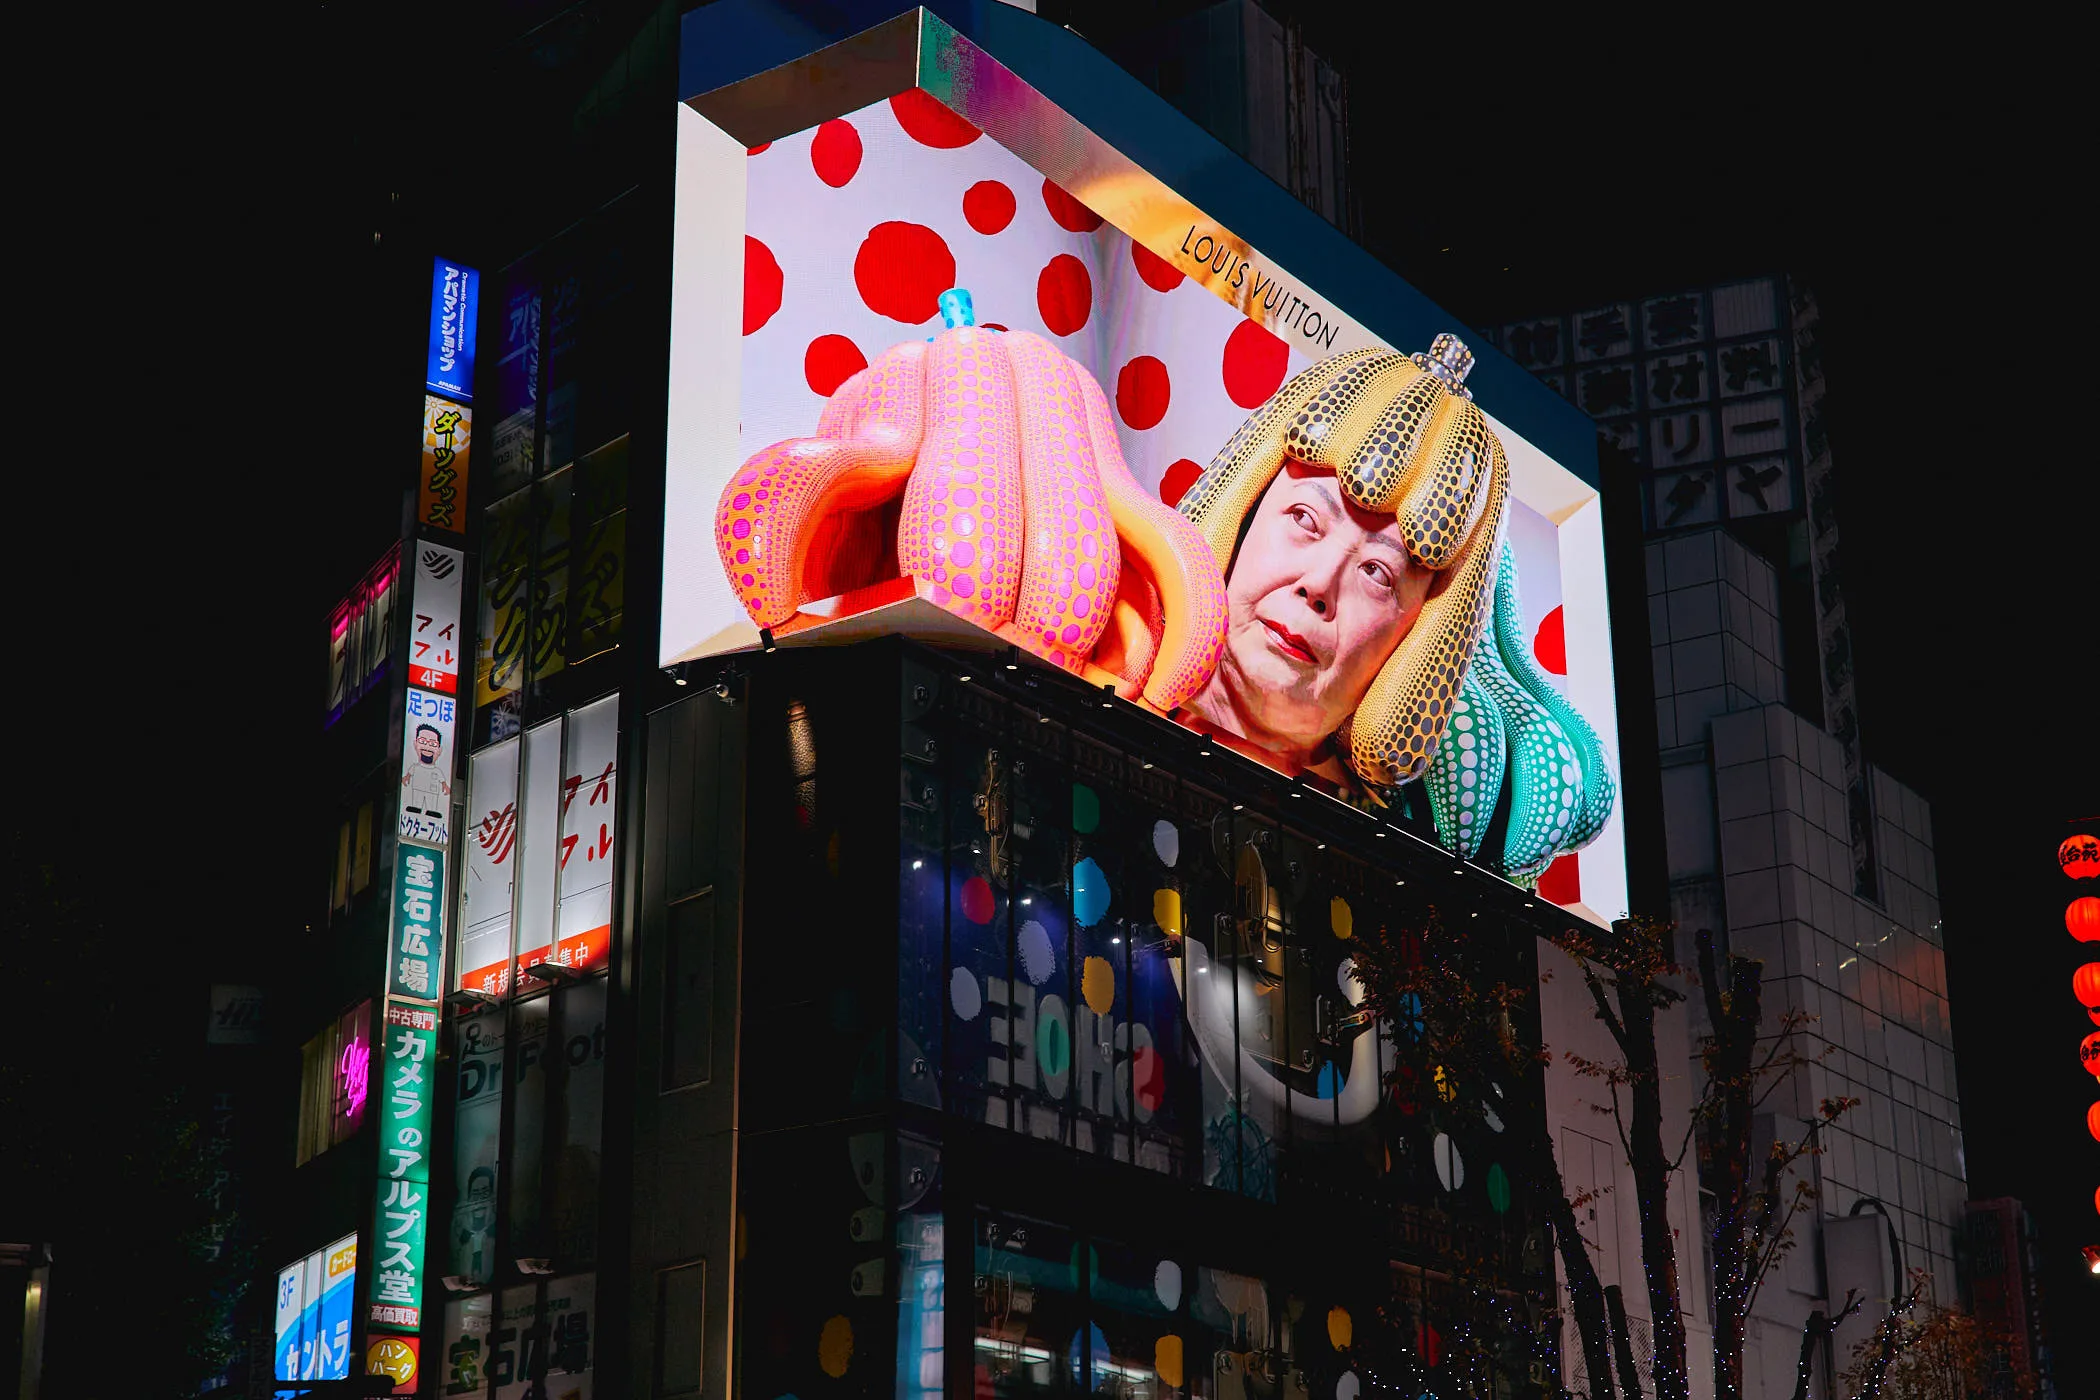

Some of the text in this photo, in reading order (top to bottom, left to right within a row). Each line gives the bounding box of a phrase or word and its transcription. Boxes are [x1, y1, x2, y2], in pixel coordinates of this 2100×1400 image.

[1181, 225, 1340, 350] LOUIS VUITTON
[440, 266, 459, 372] アパマンショップ
[457, 272, 468, 352] Dramatic Communication
[429, 411, 462, 527] ダーツグッズ
[416, 613, 455, 641] アイ
[414, 641, 454, 665] フル
[420, 669, 443, 688] 4F
[400, 814, 448, 844] ドクターフット
[399, 855, 435, 993] 宝石広場
[388, 1007, 435, 1031] 中古専門
[377, 1031, 427, 1303] カメラのアルプス堂
[280, 1275, 295, 1310] 3F
[370, 1304, 418, 1326] 高価買取
[286, 1319, 349, 1381] セントラ
